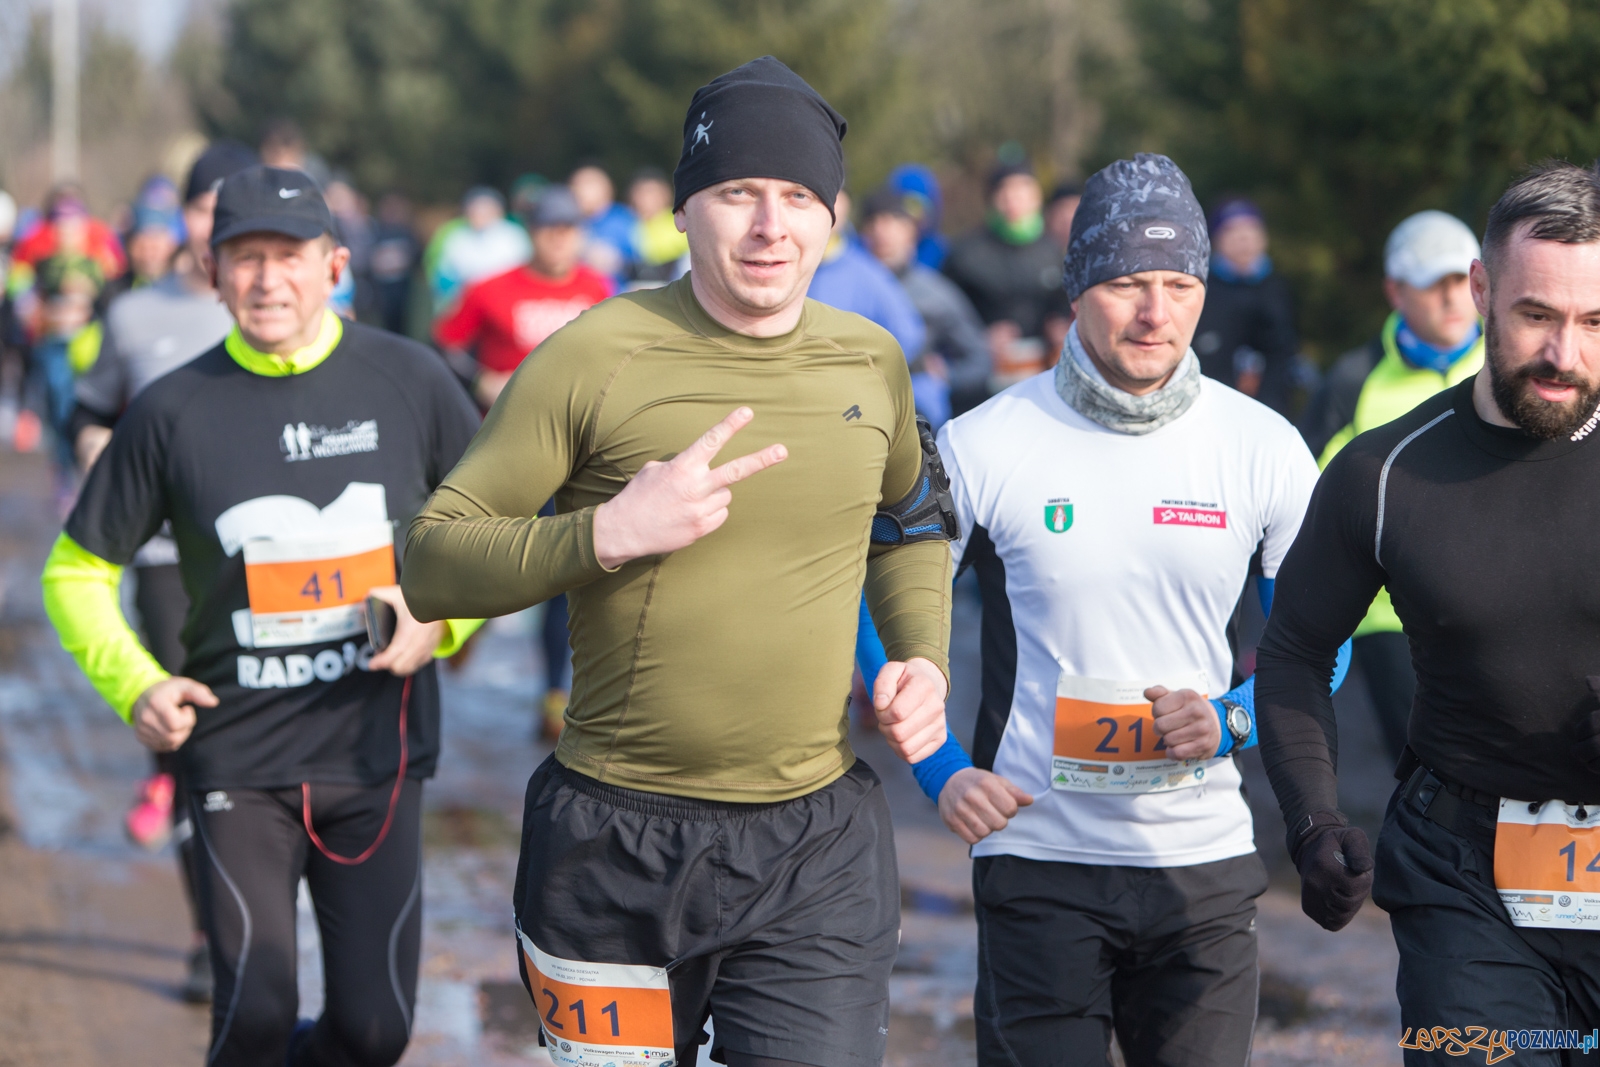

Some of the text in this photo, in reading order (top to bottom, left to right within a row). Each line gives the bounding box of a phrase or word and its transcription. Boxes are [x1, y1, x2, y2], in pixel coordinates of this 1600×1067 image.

[1177, 511, 1221, 525] TAURON
[301, 569, 344, 602] 41
[542, 988, 620, 1037] 211
[582, 1047, 615, 1055] Volkswagen
[651, 1050, 670, 1058] mjp
